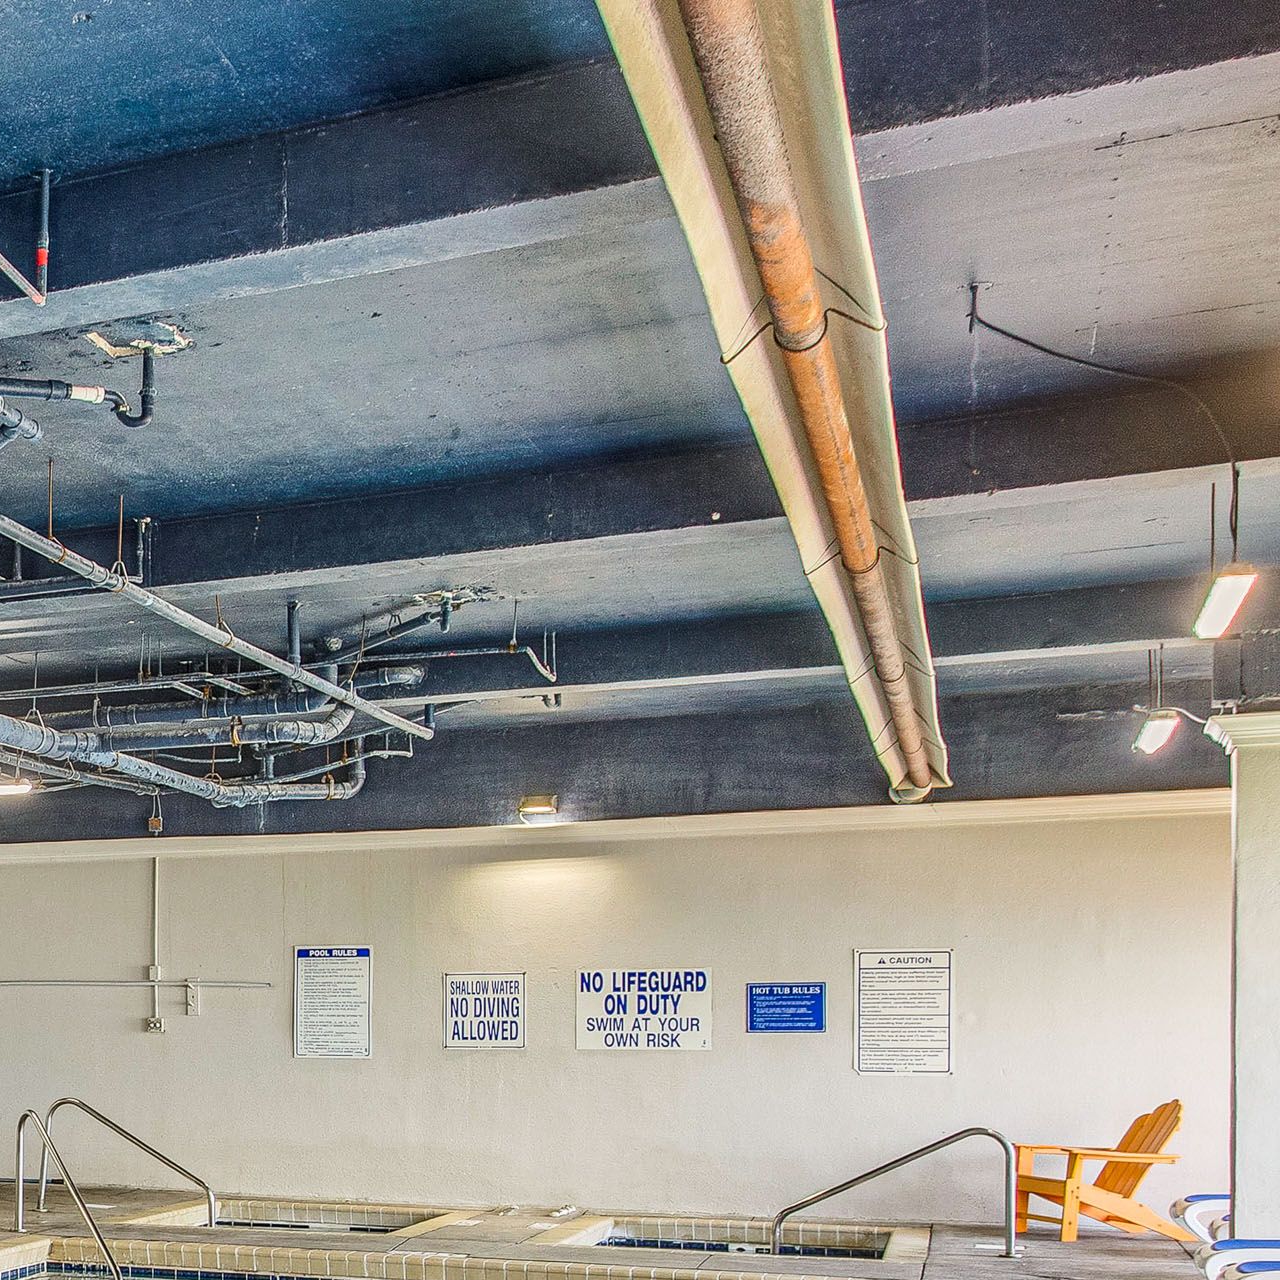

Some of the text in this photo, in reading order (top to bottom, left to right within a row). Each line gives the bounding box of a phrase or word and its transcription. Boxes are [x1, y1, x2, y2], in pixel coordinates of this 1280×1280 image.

[332, 949, 358, 957] RULES
[450, 980, 520, 995] SHALLOW WATER
[580, 970, 707, 993] NO LIFEGUARD
[792, 986, 821, 994] RULES
[450, 997, 520, 1018] NO DIVING
[604, 994, 682, 1015] ON DUTY
[451, 1020, 519, 1040] ALLOWED
[586, 1017, 700, 1032] SWIM AT YOUR
[604, 1033, 681, 1047] OWN RISK
